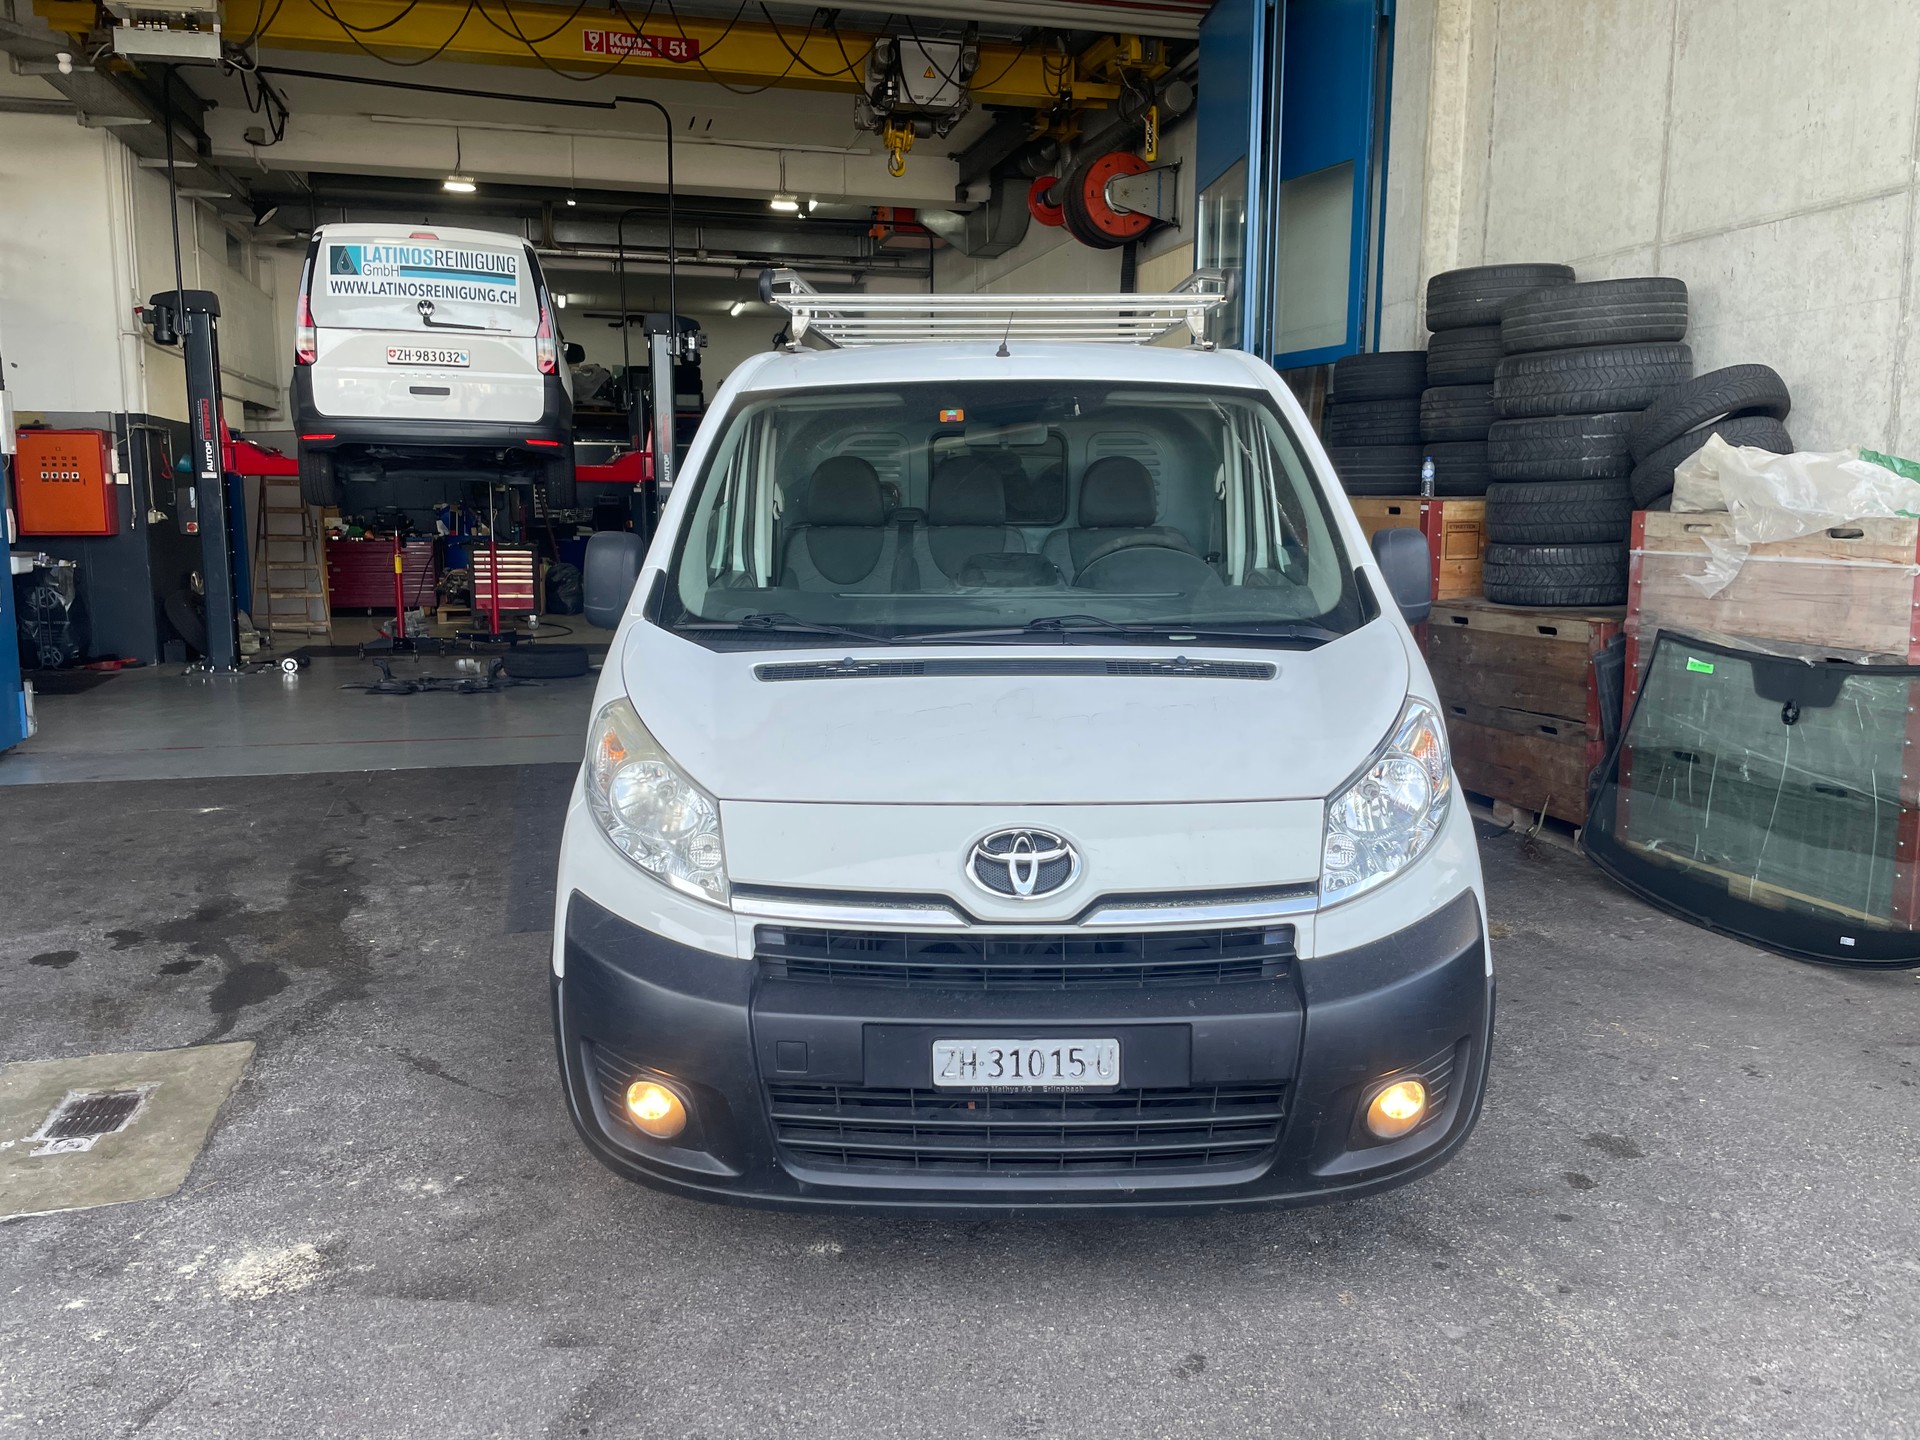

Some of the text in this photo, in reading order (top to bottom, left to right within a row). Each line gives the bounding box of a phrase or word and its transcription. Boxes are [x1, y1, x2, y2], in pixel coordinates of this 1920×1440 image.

[669, 41, 688, 57] 5t
[362, 263, 400, 277] GmbH
[363, 246, 516, 274] LATINOSREINIGUNG
[330, 280, 517, 305] WWW.LATINOSREINIGUNG.CH
